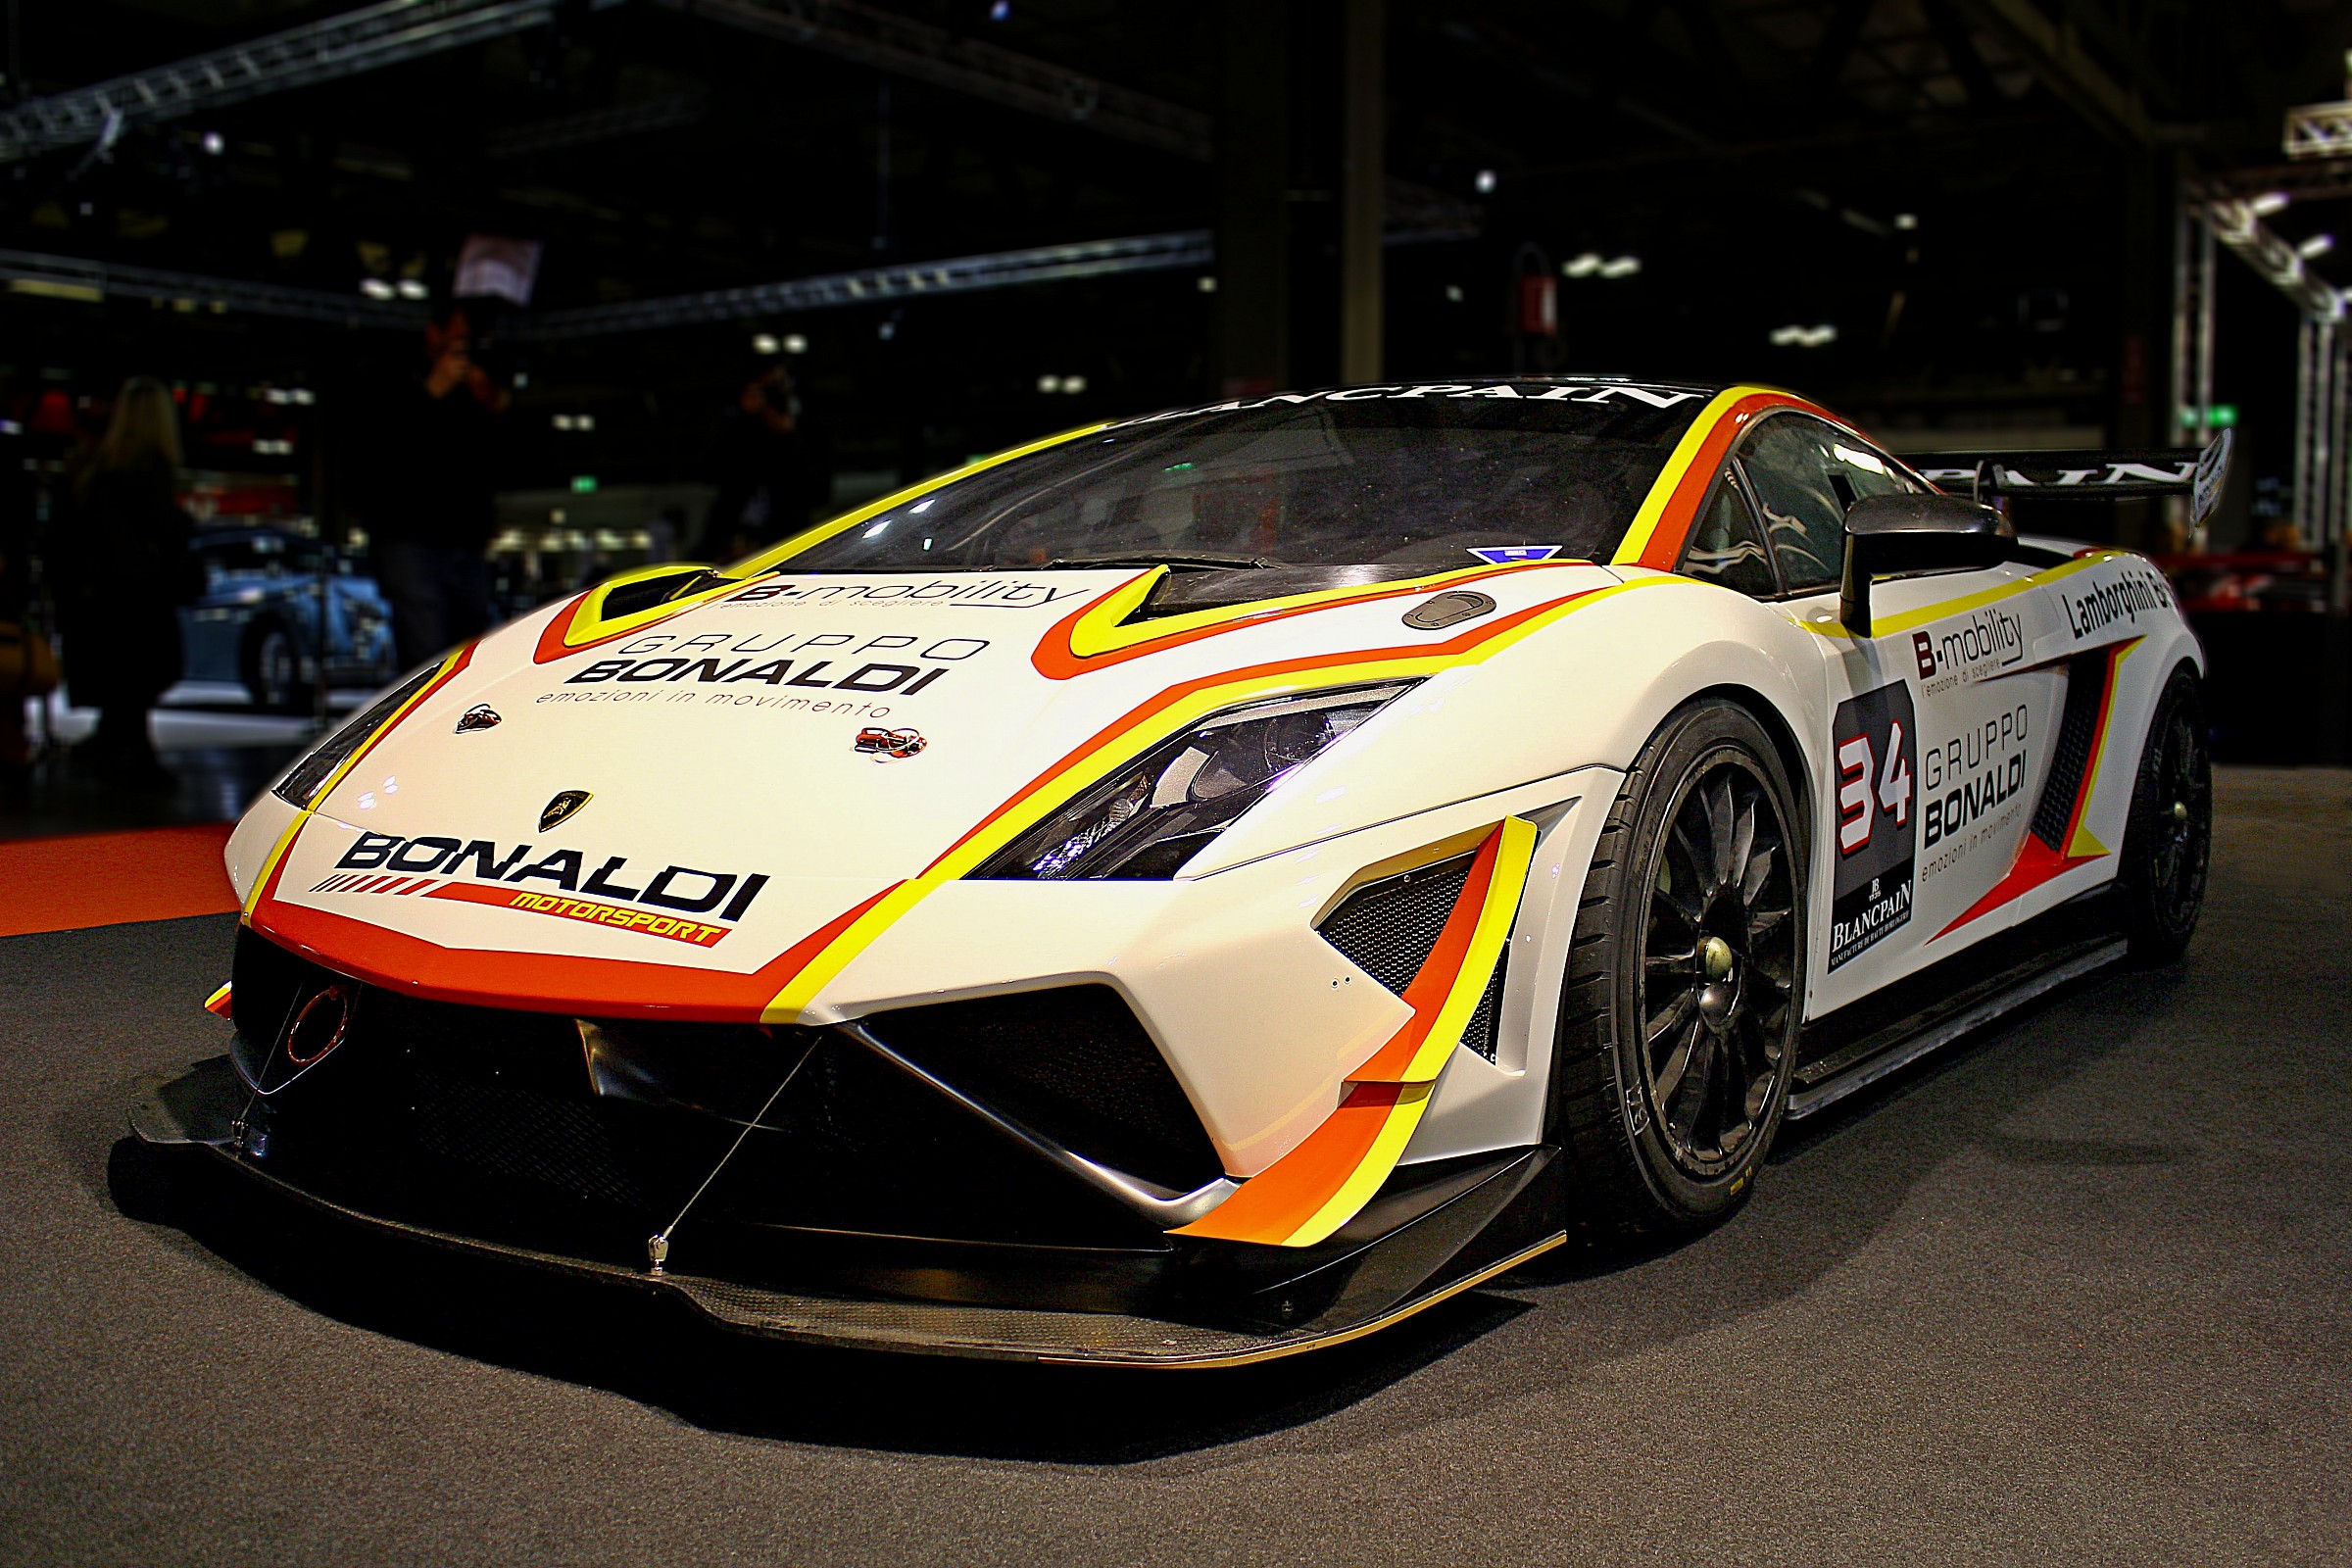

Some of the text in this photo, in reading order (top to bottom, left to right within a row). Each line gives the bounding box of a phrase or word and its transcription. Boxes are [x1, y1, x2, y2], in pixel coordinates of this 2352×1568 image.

[2061, 570, 2158, 640] Lamborghini
[564, 658, 950, 695] BONALDI
[617, 634, 990, 661] GRUPPO
[536, 689, 890, 718] emozioni in movimento
[1926, 704, 2028, 791] GRUPPO
[1838, 718, 1913, 856] 34
[1924, 750, 2027, 851] BONALDI
[334, 831, 771, 922] BONALDI
[1922, 838, 1967, 882] emozioni
[508, 892, 723, 944] MOTORSPORT
[1832, 879, 1912, 953] BLANCPAIN
